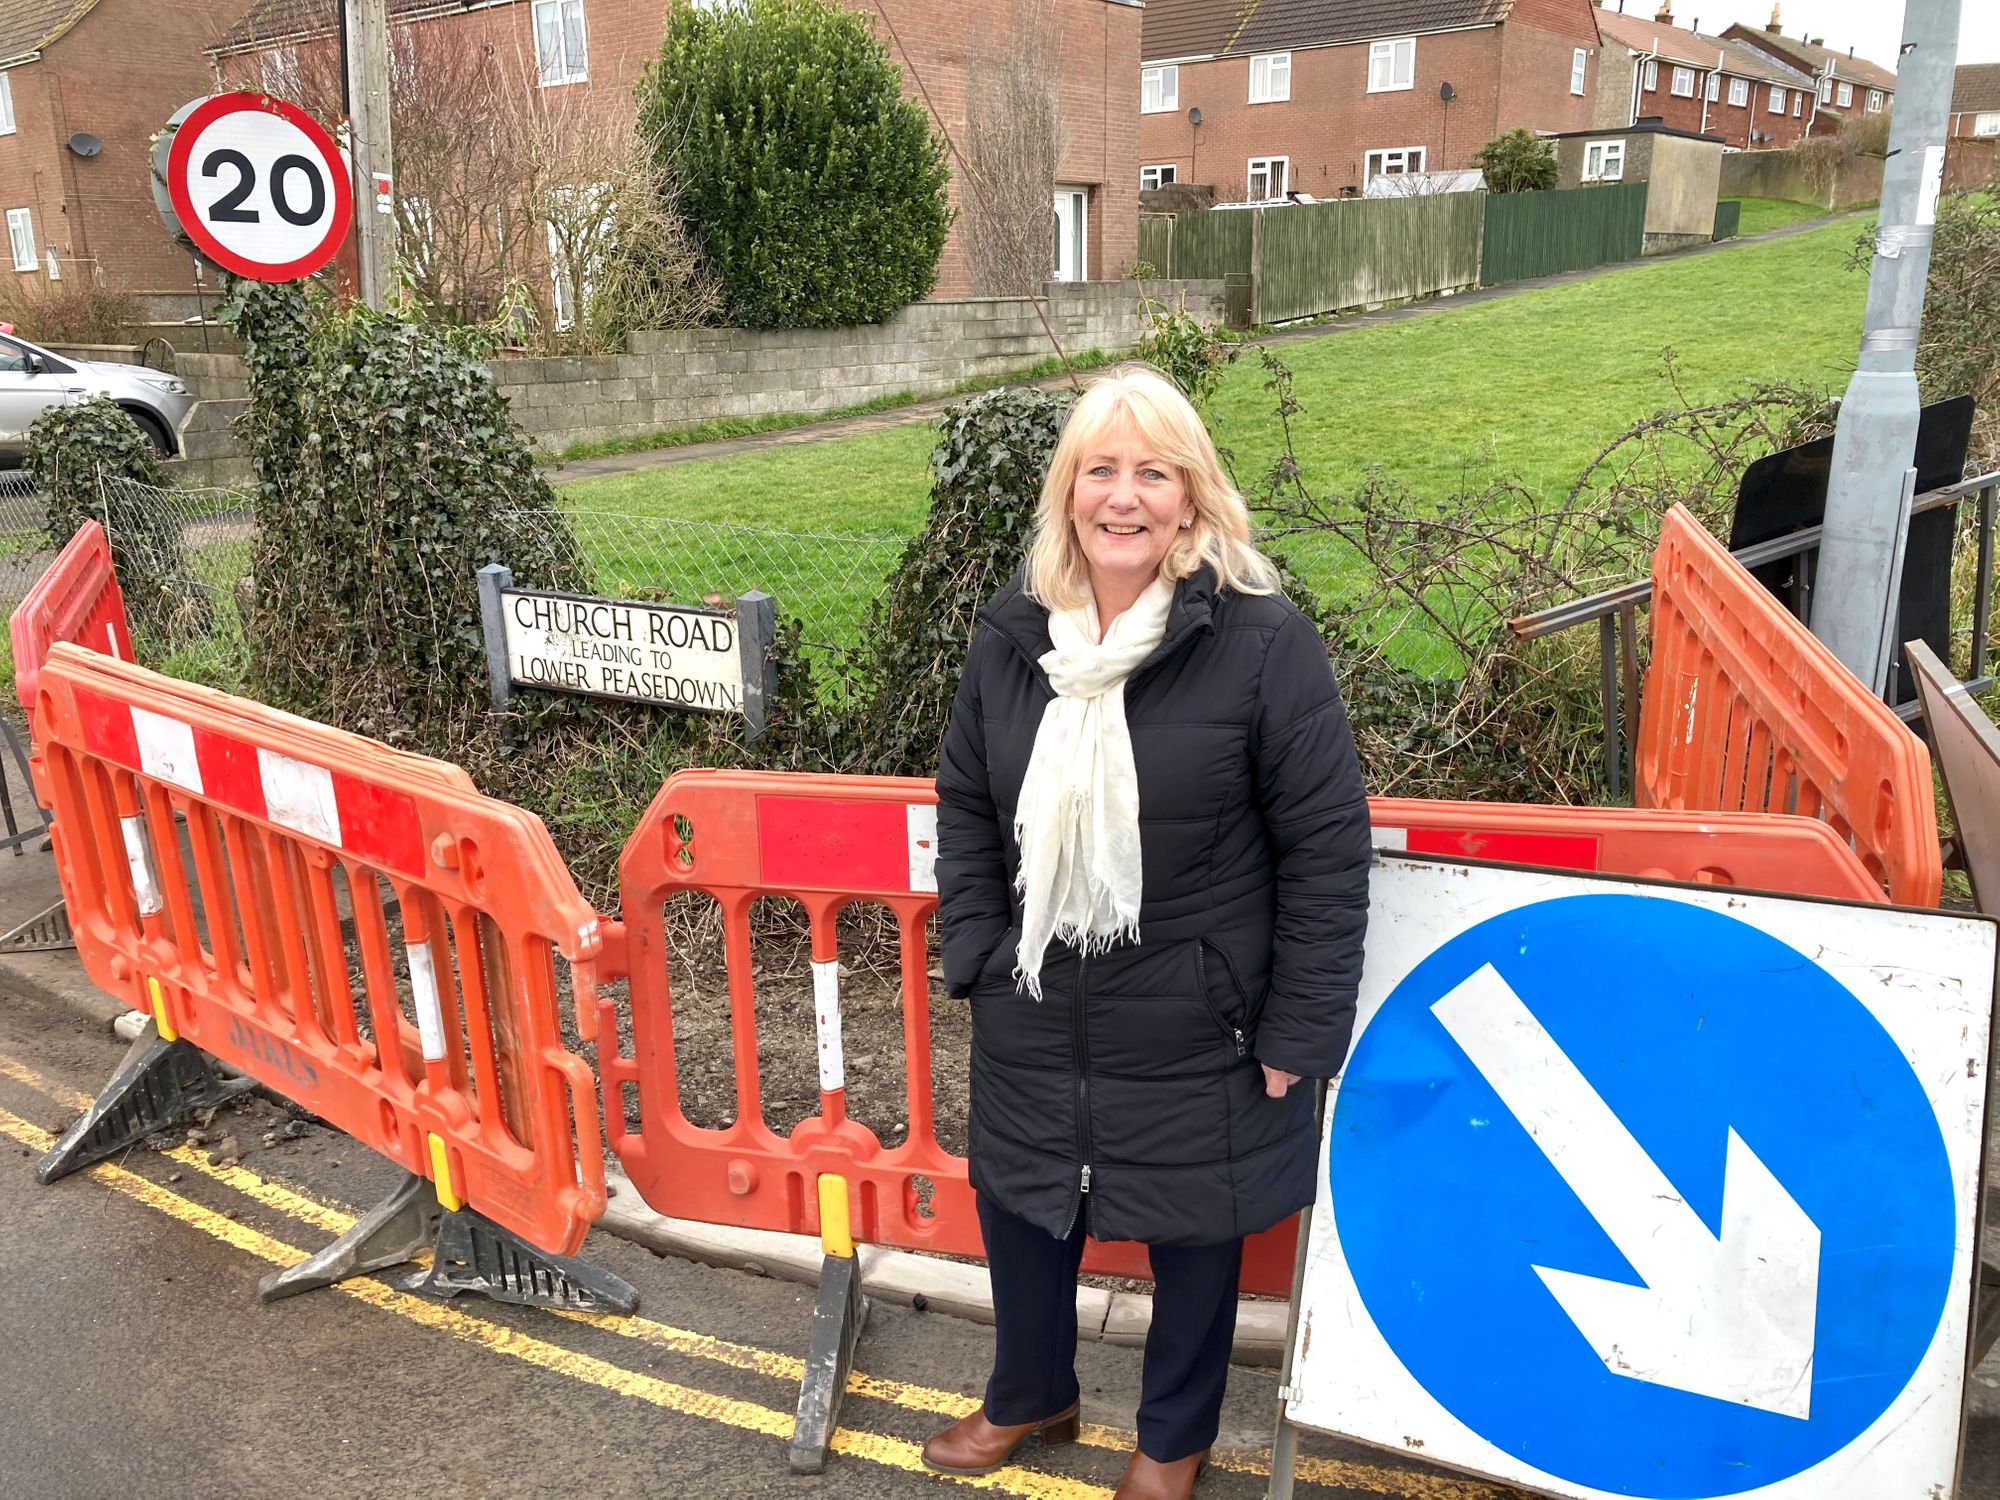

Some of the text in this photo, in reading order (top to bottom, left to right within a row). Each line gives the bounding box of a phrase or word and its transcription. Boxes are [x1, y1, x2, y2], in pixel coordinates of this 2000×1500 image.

[202, 149, 326, 226] 20
[515, 597, 734, 652] CHURCH ROAD
[520, 655, 736, 708] LOWER PEASEDOWN
[572, 640, 673, 670] LEADING TO
